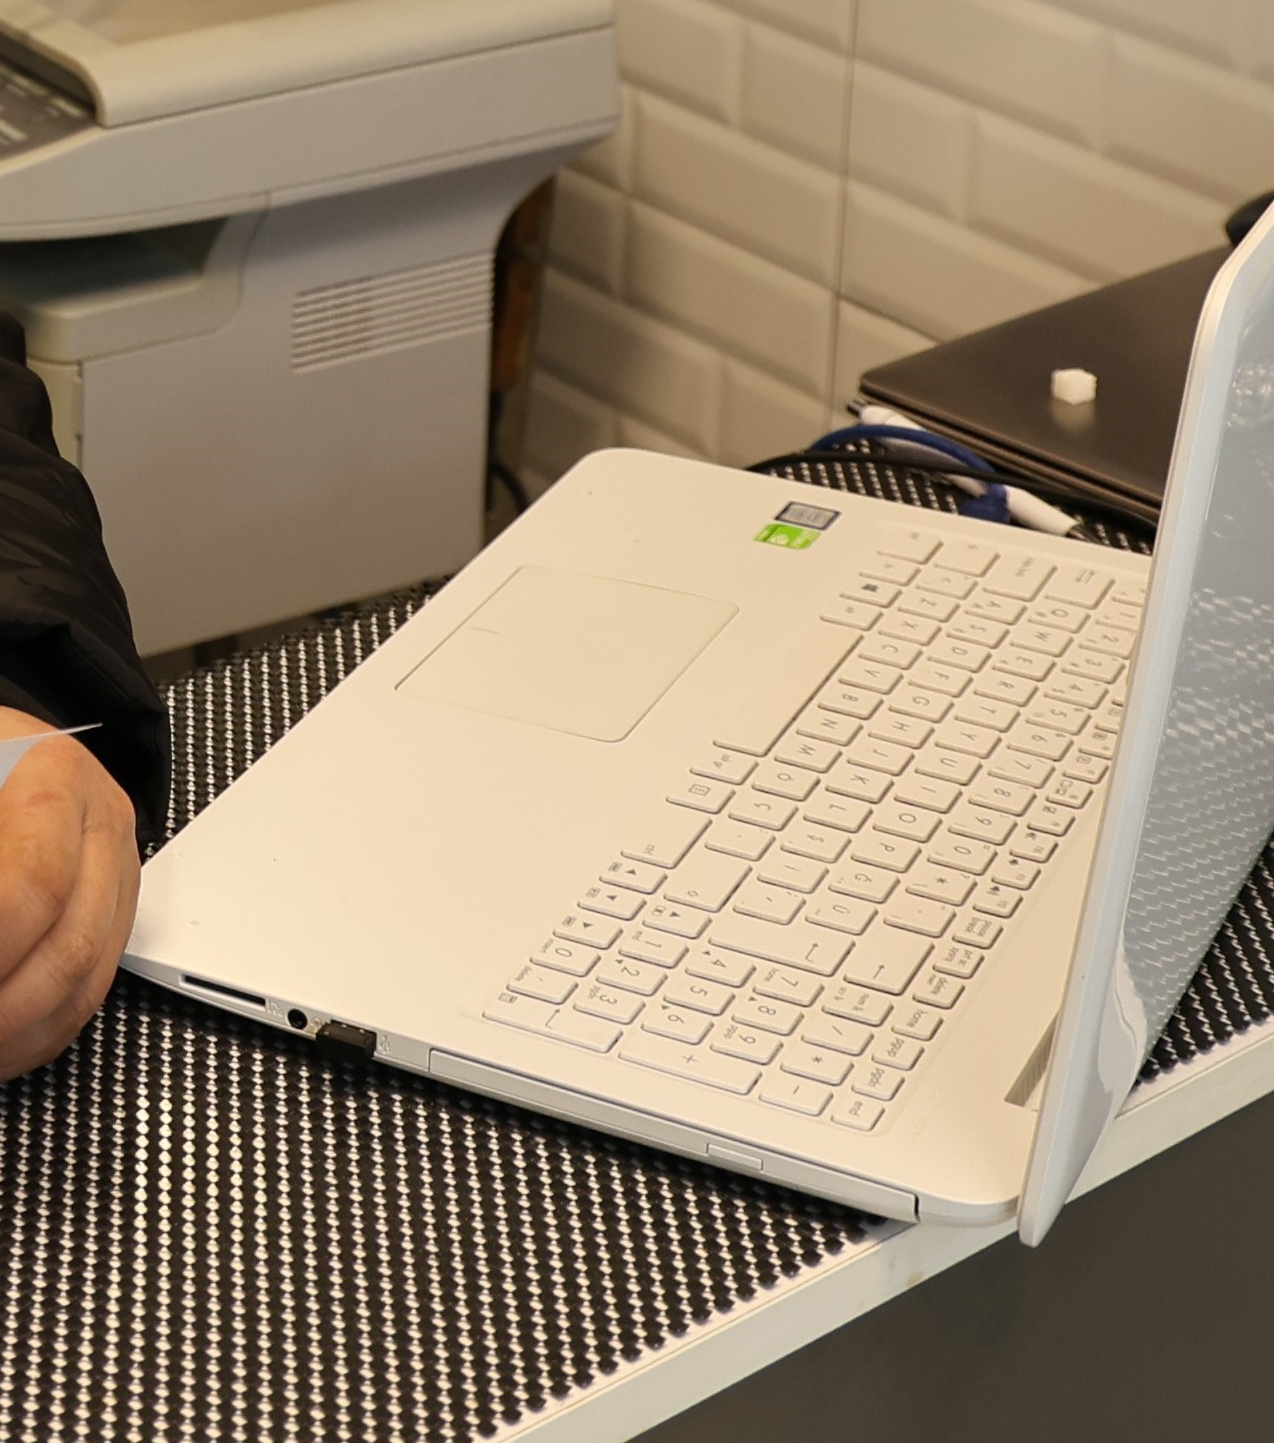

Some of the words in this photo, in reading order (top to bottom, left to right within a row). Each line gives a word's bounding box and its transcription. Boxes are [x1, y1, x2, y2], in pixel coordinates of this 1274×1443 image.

[902, 620, 919, 631] X
[1034, 632, 1051, 642] W
[882, 645, 899, 654] C
[952, 648, 968, 656] D
[1016, 656, 1033, 666] E
[864, 669, 880, 678] V
[934, 671, 949, 681] F
[997, 680, 1014, 690] R
[842, 694, 859, 702] B
[912, 696, 930, 706] G
[980, 706, 996, 715] T
[1050, 708, 1067, 718] 5
[820, 718, 838, 729] N
[892, 721, 910, 732] H
[960, 731, 977, 741] Y
[1031, 734, 1048, 744] 6
[797, 744, 816, 756] M
[940, 758, 958, 767] U
[850, 774, 869, 785] K
[994, 787, 1011, 798] 8
[976, 816, 992, 826] 9
[879, 842, 895, 852] P
[621, 966, 640, 978] 2
[690, 985, 708, 997] 5
[600, 995, 619, 1006] 3
[757, 1005, 777, 1016] 8
